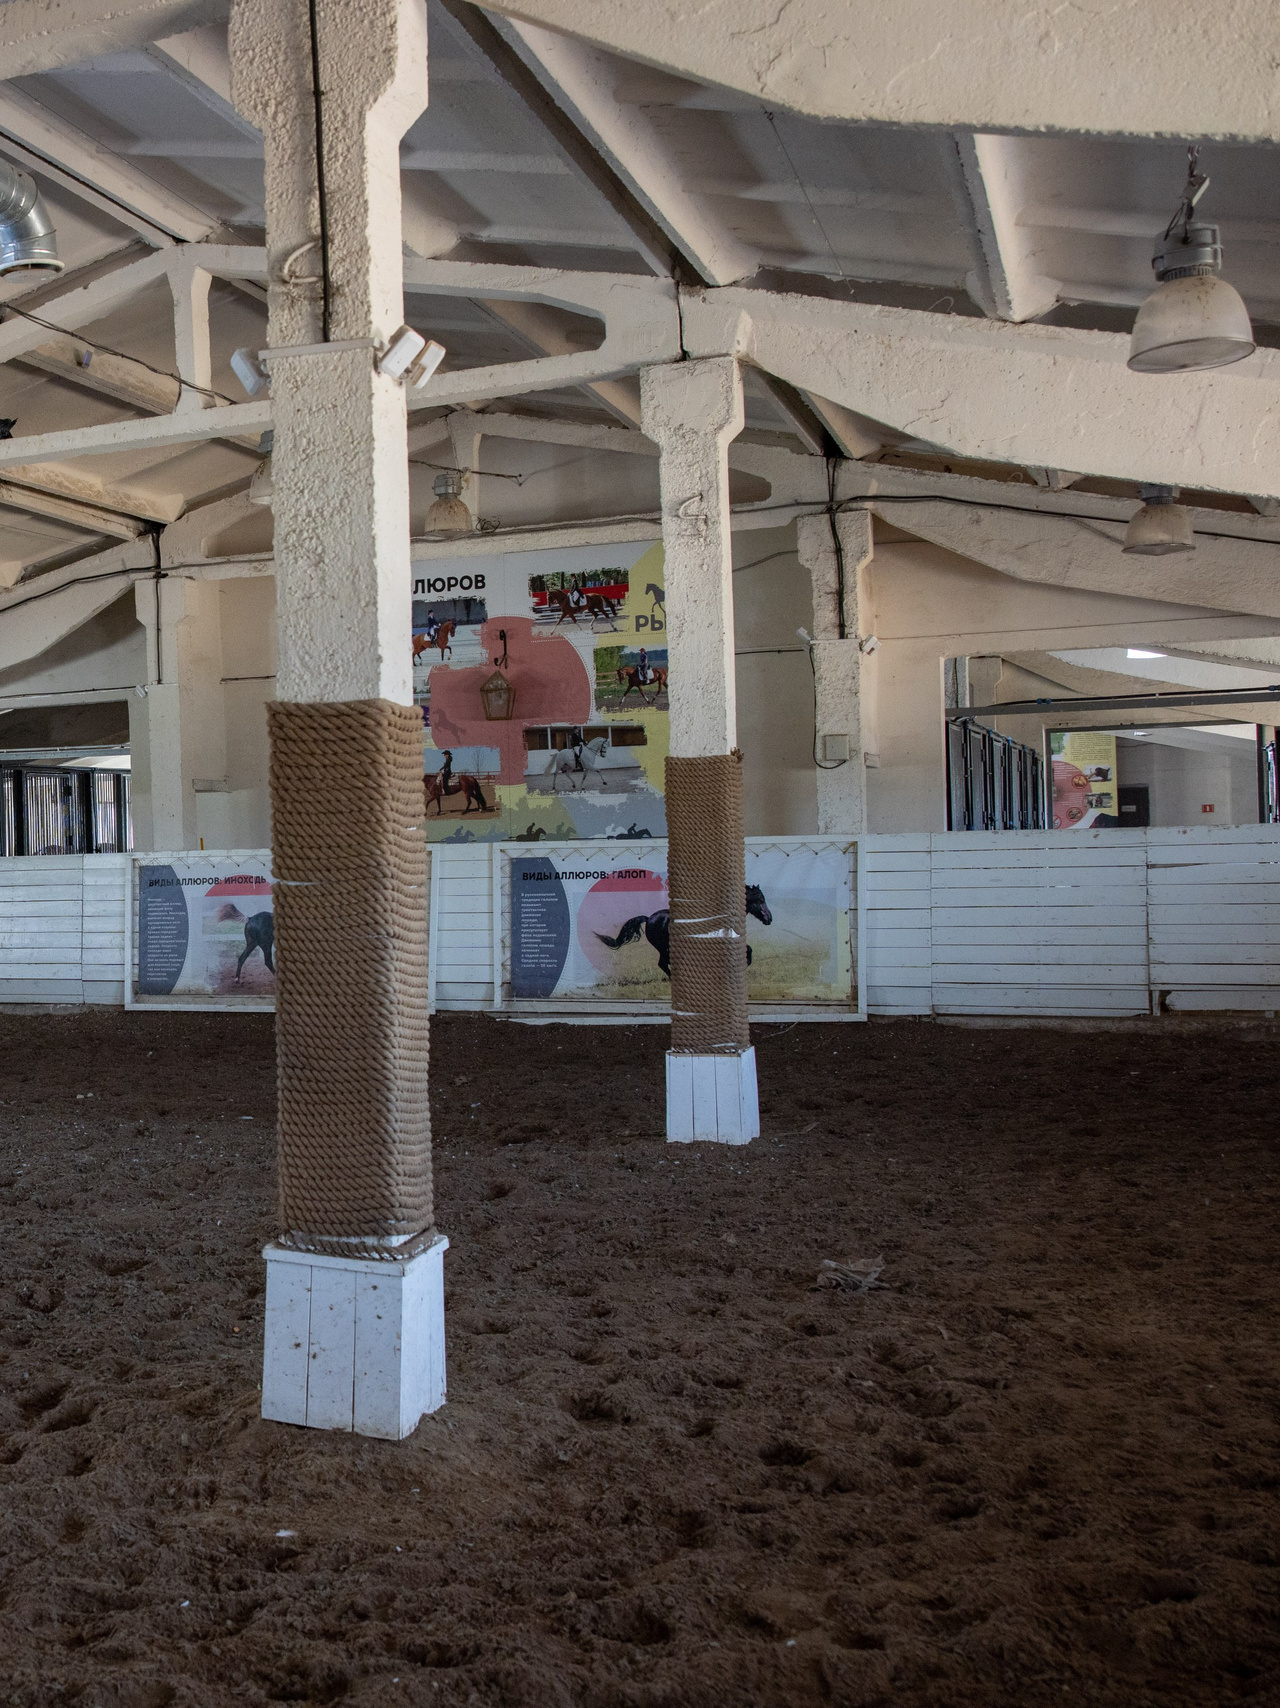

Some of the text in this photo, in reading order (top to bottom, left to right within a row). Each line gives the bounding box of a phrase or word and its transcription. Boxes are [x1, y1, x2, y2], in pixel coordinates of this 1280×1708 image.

[412, 573, 486, 595] ЛЮРОВ
[522, 871, 552, 881] ВИДЫ
[554, 870, 610, 880] АЛЛЮРОВ:
[148, 878, 174, 887] ВИДЫ
[177, 876, 222, 886] АЛЛЮРОВ:
